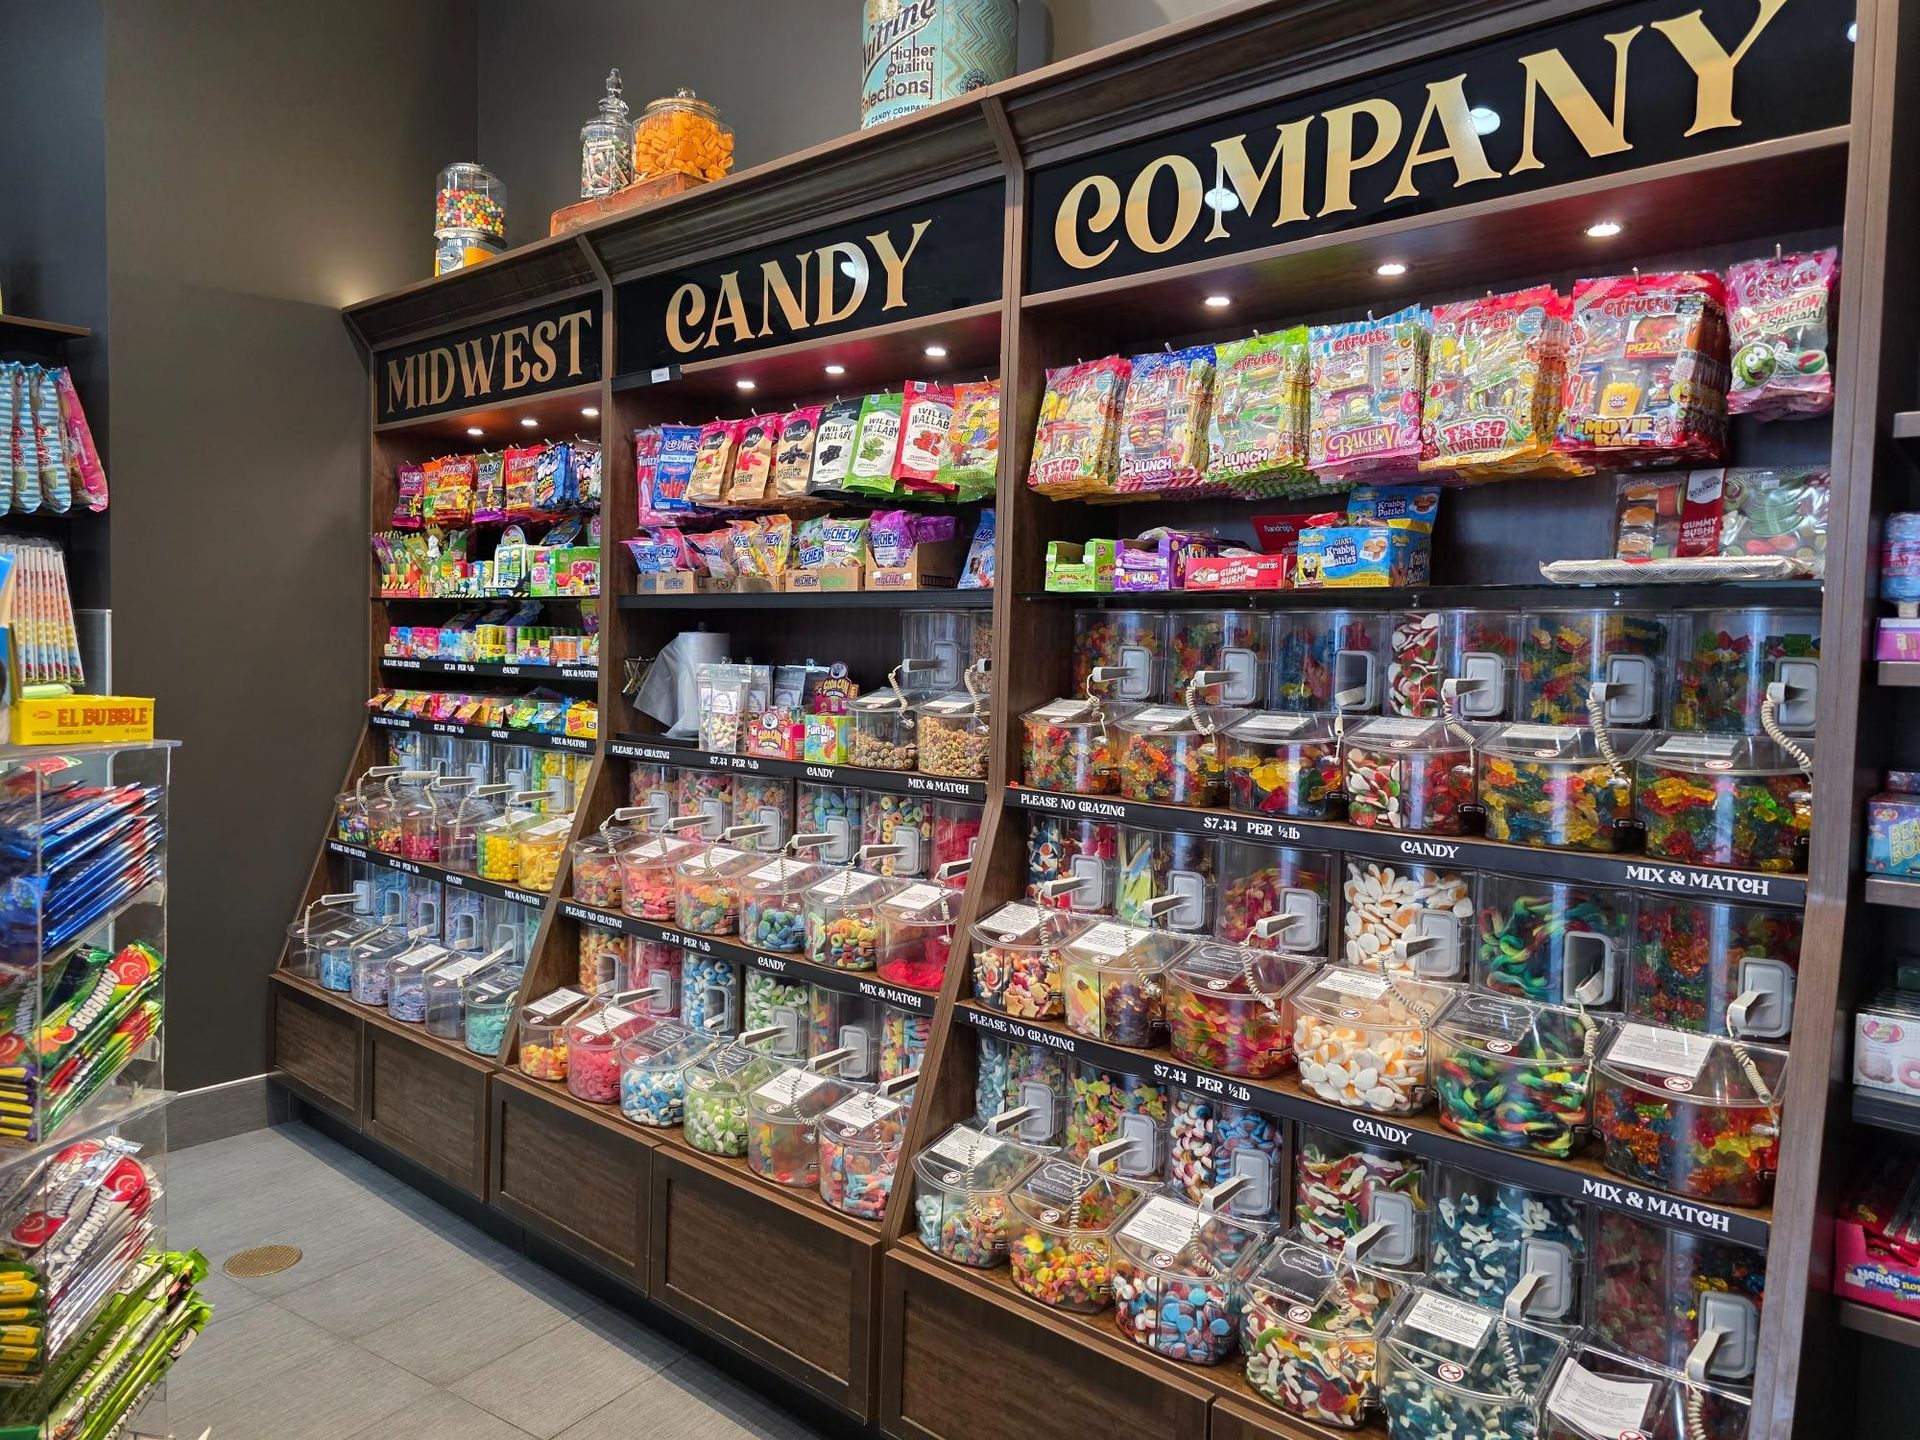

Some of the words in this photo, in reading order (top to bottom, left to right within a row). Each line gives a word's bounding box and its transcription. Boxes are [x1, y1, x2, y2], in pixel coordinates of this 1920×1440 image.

[890, 34, 936, 62] Higher
[885, 58, 934, 86] Quality
[871, 109, 892, 124] CANDY
[1055, 0, 1790, 269] COMPANY
[665, 219, 932, 353] CANDY
[1602, 293, 1676, 319] efrutti
[1766, 307, 1824, 331] Splash!
[1333, 329, 1392, 353] efrutti
[1627, 342, 1661, 353] PIZZA
[387, 309, 593, 414] MIDWEST
[1232, 350, 1284, 373] efrutti
[1608, 401, 1628, 409] CORN
[868, 417, 897, 426] WILEY
[912, 414, 950, 430] WALLAB
[918, 407, 953, 421] WILEY
[863, 424, 900, 439] WALLABY
[1584, 417, 1655, 437] MOVIE
[819, 430, 853, 443] WALLABY
[1338, 428, 1400, 458] BAKERY
[1449, 436, 1503, 454] TWOSDAY
[1134, 456, 1173, 474] LUNCH
[1223, 449, 1269, 466] LUNCH
[1377, 506, 1406, 517] Patties
[1378, 501, 1406, 512] Krabby
[1683, 517, 1718, 529] GUMMY
[822, 528, 861, 542] HI-CHEW
[873, 532, 900, 548] HI-CHEW
[1684, 528, 1715, 538] SUSHI
[1334, 538, 1353, 546] GIANT
[1326, 545, 1356, 559] Krabby
[1332, 555, 1357, 568] atties
[1220, 567, 1249, 577] GUMMY
[1221, 574, 1246, 585] SUSHI
[795, 576, 818, 587] HI-CHEW
[57, 708, 79, 727] EL
[82, 707, 148, 727] BUBBLE
[807, 724, 821, 737] Fun
[821, 724, 834, 740] Dip
[612, 745, 633, 755] PLEASE
[634, 748, 643, 756] NO
[644, 749, 669, 759] GRAZING
[732, 758, 745, 767] PER
[807, 767, 834, 778] CANDY
[908, 778, 925, 789] MIX
[926, 780, 934, 789] &
[935, 780, 970, 795] MATCH
[1021, 793, 1058, 808] PLEASE
[1061, 795, 1077, 810] NO
[1079, 800, 1126, 818] GRAZING
[1246, 820, 1273, 836] PER
[1401, 840, 1459, 859] CANDY
[1626, 865, 1665, 884] MIX
[1668, 871, 1685, 885] &
[1689, 871, 1769, 895] MATCH
[566, 905, 587, 918] PLEASE
[588, 912, 598, 921] NO
[598, 914, 622, 928] GRAZING
[684, 936, 697, 948] PER
[758, 956, 786, 972] CANDY
[69, 968, 120, 1031] AIRHEADS
[860, 981, 877, 995] MIX
[878, 988, 885, 998] &
[887, 990, 921, 1008] MATCH
[970, 1012, 1007, 1031] PLEASE
[1010, 1022, 1025, 1036] NO
[1028, 1029, 1075, 1052] GRAZING
[1196, 1074, 1223, 1094] PER
[1353, 1117, 1413, 1145] CANDY
[1582, 1179, 1622, 1203] MIX
[1626, 1189, 1645, 1208] &
[1648, 1195, 1730, 1233] MATCH
[64, 1184, 114, 1257] AIRHEADS
